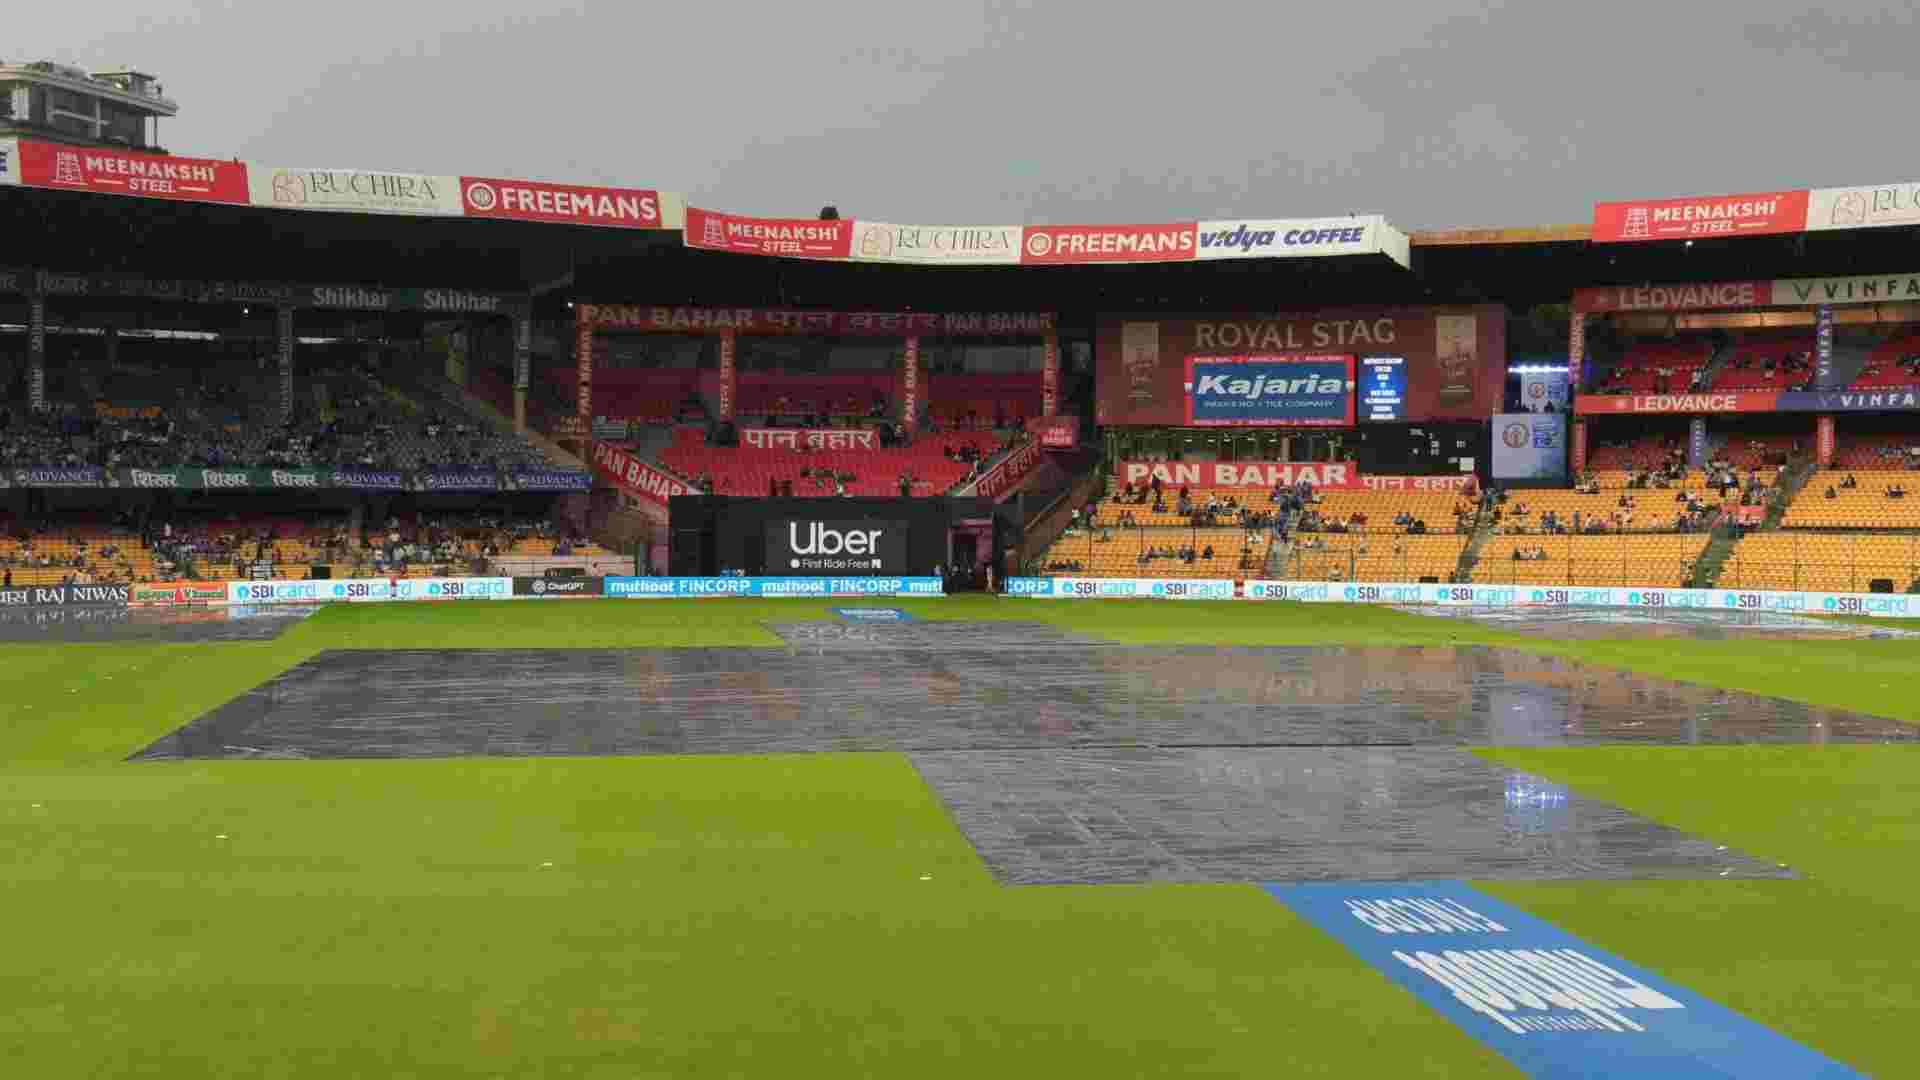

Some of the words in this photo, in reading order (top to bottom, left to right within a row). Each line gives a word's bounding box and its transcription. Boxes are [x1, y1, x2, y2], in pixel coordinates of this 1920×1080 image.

[84, 156, 216, 184] MEENAKSHI
[129, 177, 176, 193] STEEL
[310, 172, 437, 200] RUCHIRA
[501, 188, 657, 220] FREEMANS
[1653, 200, 1776, 222] MEENAKSHI
[728, 222, 839, 242] MEENAKSHI
[1691, 219, 1735, 233] STEEL
[896, 227, 1009, 250] RUCHIRA
[1056, 231, 1193, 255] FREEMANS
[1200, 224, 1276, 252] vidya
[1284, 226, 1365, 246] COFFEE
[761, 240, 804, 253] STEEL
[312, 286, 389, 308] Shikhar
[423, 289, 500, 311] Shikhar
[1617, 283, 1755, 309] LEDVANCE
[1195, 323, 1304, 349] ROYAL
[1312, 319, 1396, 347] STAG
[1197, 373, 1343, 400] Kajaria
[1633, 395, 1738, 412] LEDVANCE
[744, 429, 798, 449] पान
[593, 443, 625, 477] PAN
[1127, 463, 1200, 484] PAN
[1215, 464, 1346, 486] BAHAR
[790, 521, 882, 554] Uber
[802, 559, 822, 569] First
[824, 559, 846, 569] Ride
[847, 559, 870, 569] Free
[73, 586, 129, 601] NIWAS
[251, 585, 274, 598] SBI
[347, 583, 368, 597] SBI
[442, 583, 464, 595] SBI
[548, 581, 585, 592] ChatGPT
[609, 579, 675, 593] muthoot
[680, 579, 752, 593] FINCORP
[761, 579, 825, 593] muthoot
[831, 579, 901, 593] FINCORP
[1074, 582, 1096, 594] SBI
[1167, 583, 1188, 595] SBI
[1266, 585, 1288, 597] SBI
[1359, 587, 1380, 599] SBI
[1452, 588, 1472, 600] SBI
[1546, 590, 1568, 602] SBI
[1642, 592, 1665, 605] SBI
[1738, 594, 1762, 607] SBI
[1839, 597, 1863, 610] SBI
